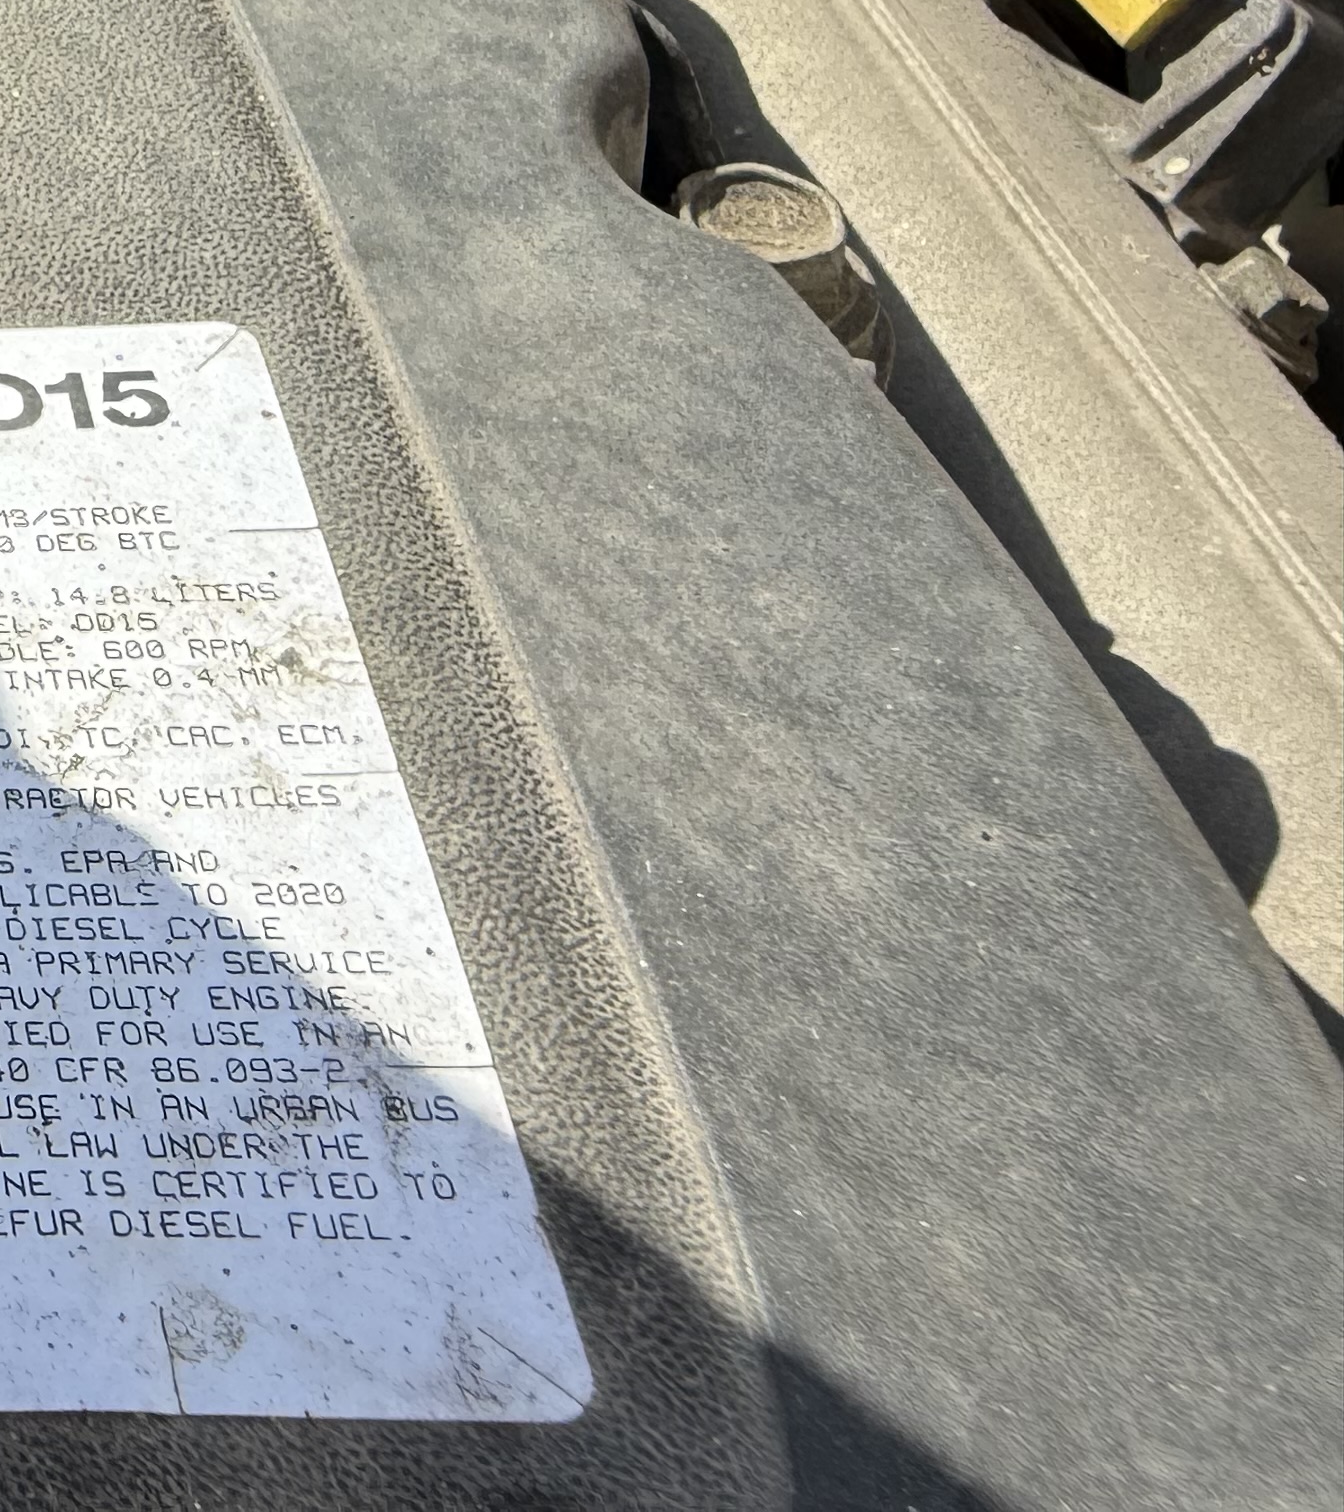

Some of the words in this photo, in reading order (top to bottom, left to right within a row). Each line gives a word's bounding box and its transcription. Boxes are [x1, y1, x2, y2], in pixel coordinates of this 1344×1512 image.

[37, 532, 98, 552] DEG
[118, 530, 181, 551] BTC
[152, 582, 281, 603] LITERS
[73, 613, 157, 633] DD15
[103, 639, 165, 660] 600
[188, 638, 253, 659] RPM
[6, 668, 131, 690] INTAKE
[153, 667, 214, 688] 0.4
[238, 666, 282, 687] MM
[62, 850, 129, 874] EPA
[154, 849, 220, 873] AND
[181, 882, 229, 907] TO
[251, 882, 346, 906] 2020
[6, 917, 144, 941] DIESEL
[167, 916, 286, 940] CYCLE
[35, 950, 195, 976] PRIMARY
[222, 950, 393, 975] SERVICE
[90, 986, 180, 1011] DUTY
[96, 1020, 168, 1047] FOR
[192, 1020, 264, 1047] USE
[292, 1020, 339, 1047] IN
[359, 1020, 413, 1048] AN
[55, 1056, 127, 1083] CFR
[93, 1094, 135, 1121] IN
[160, 1094, 210, 1121] AN
[232, 1094, 361, 1123] URBAN
[382, 1095, 459, 1122] BUS
[45, 1131, 119, 1159] LAW
[142, 1133, 267, 1160] UNDER
[292, 1134, 370, 1161] THE
[80, 1170, 126, 1197] IS
[152, 1171, 380, 1200] CERTIFIED
[404, 1172, 457, 1200] TO
[109, 1210, 262, 1239] DIESEL
[287, 1212, 412, 1241] FUEL.
